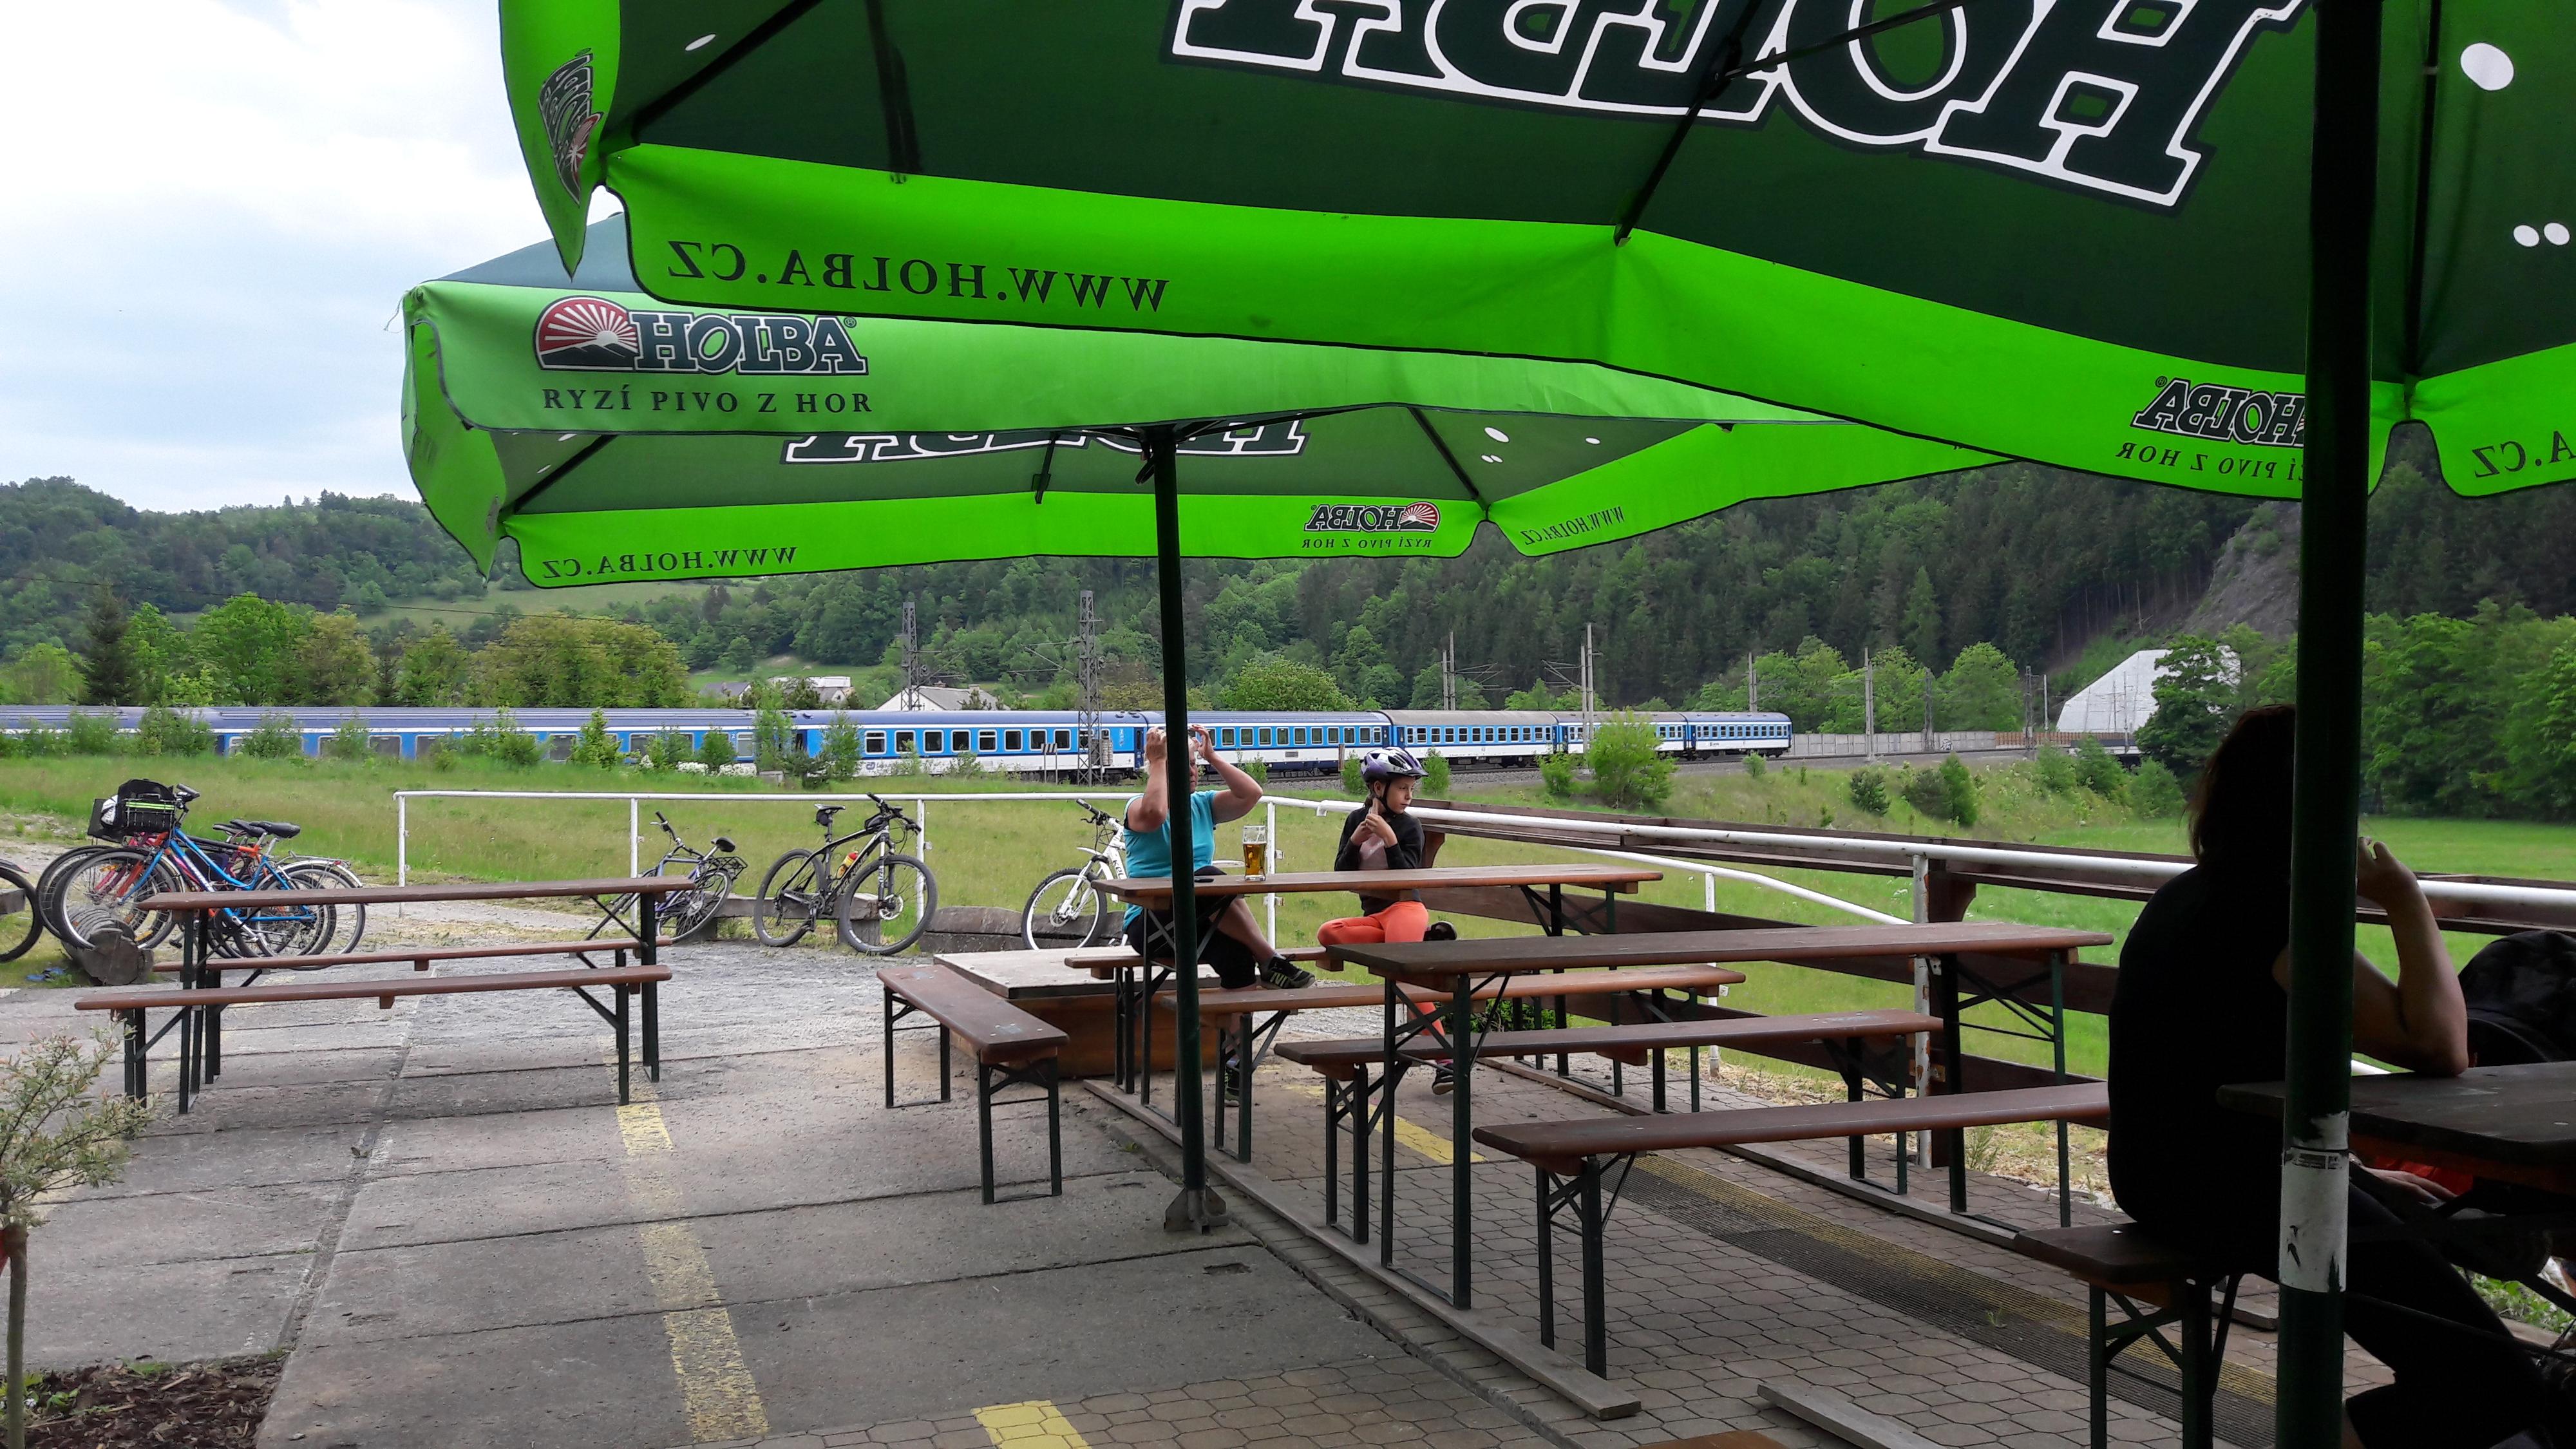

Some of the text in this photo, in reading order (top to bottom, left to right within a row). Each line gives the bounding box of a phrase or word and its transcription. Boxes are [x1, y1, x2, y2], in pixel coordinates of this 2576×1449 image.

[628, 310, 869, 375] HOLBA
[543, 384, 873, 413] RYZÍ PIVO Z HOR
